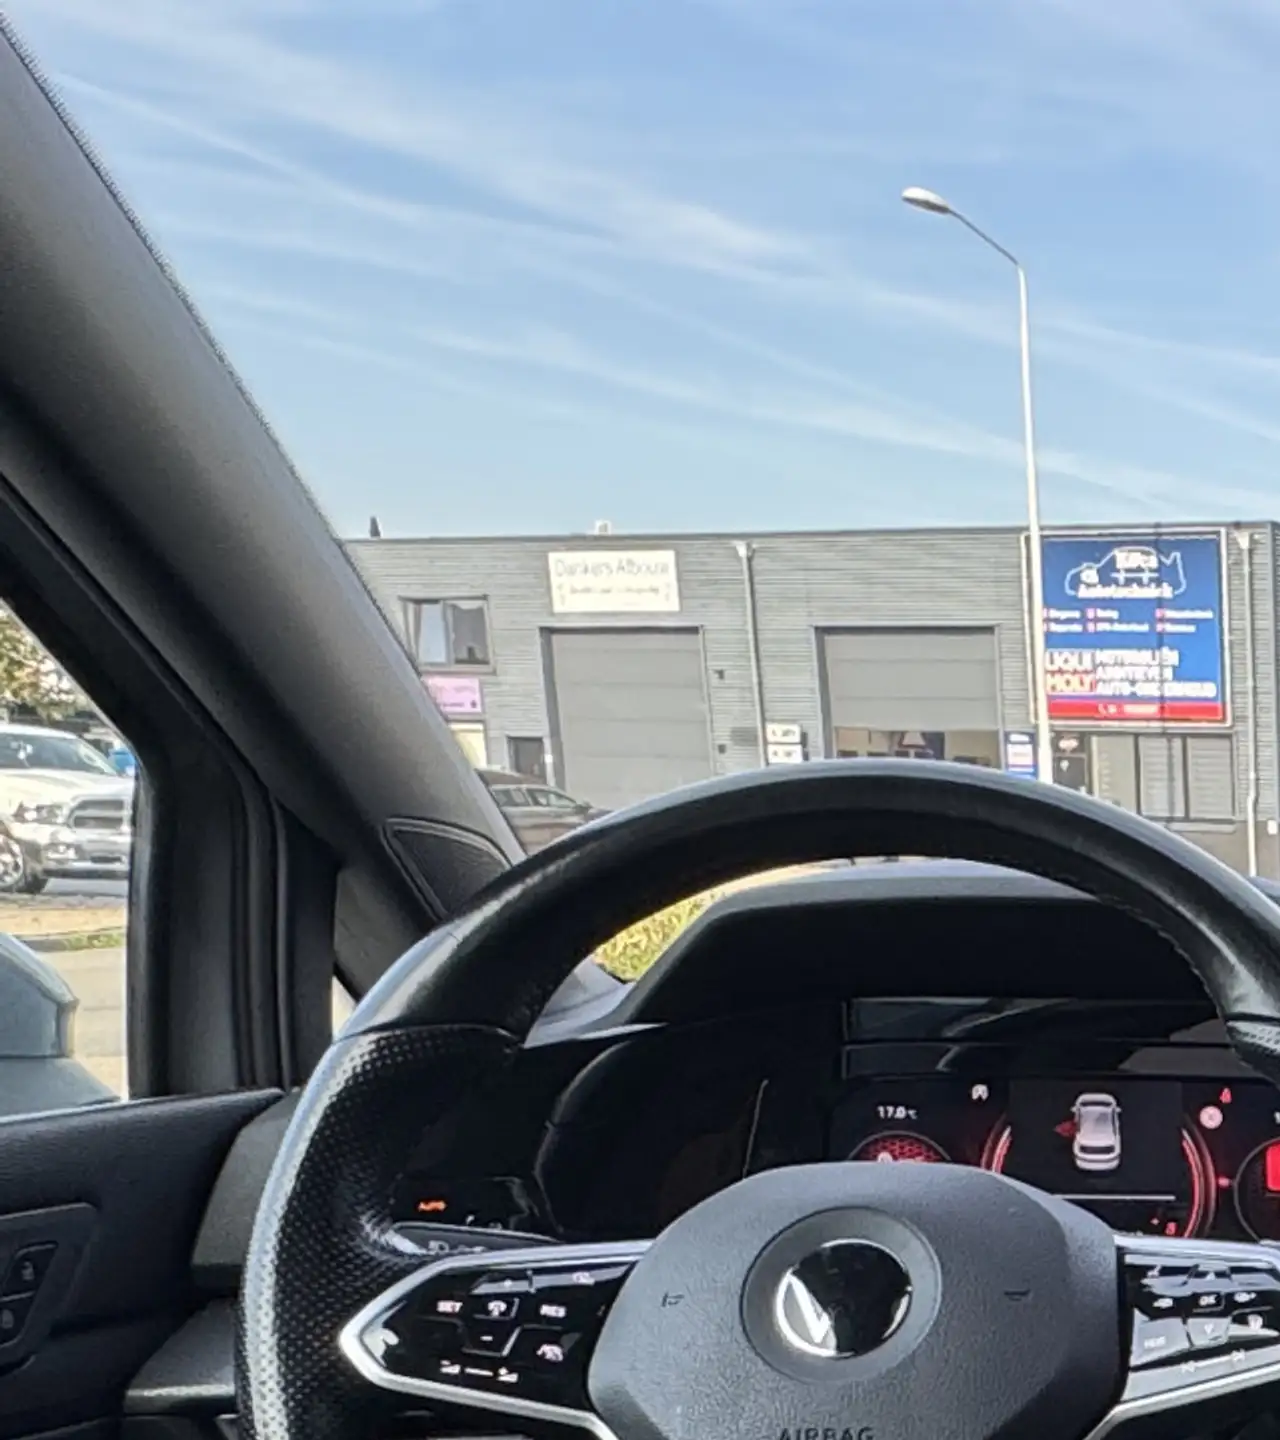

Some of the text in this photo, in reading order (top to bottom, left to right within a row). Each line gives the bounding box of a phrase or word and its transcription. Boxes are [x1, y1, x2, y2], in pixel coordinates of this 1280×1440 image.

[1198, 1294, 1218, 1307] OK
[436, 1300, 567, 1318] SET RES
